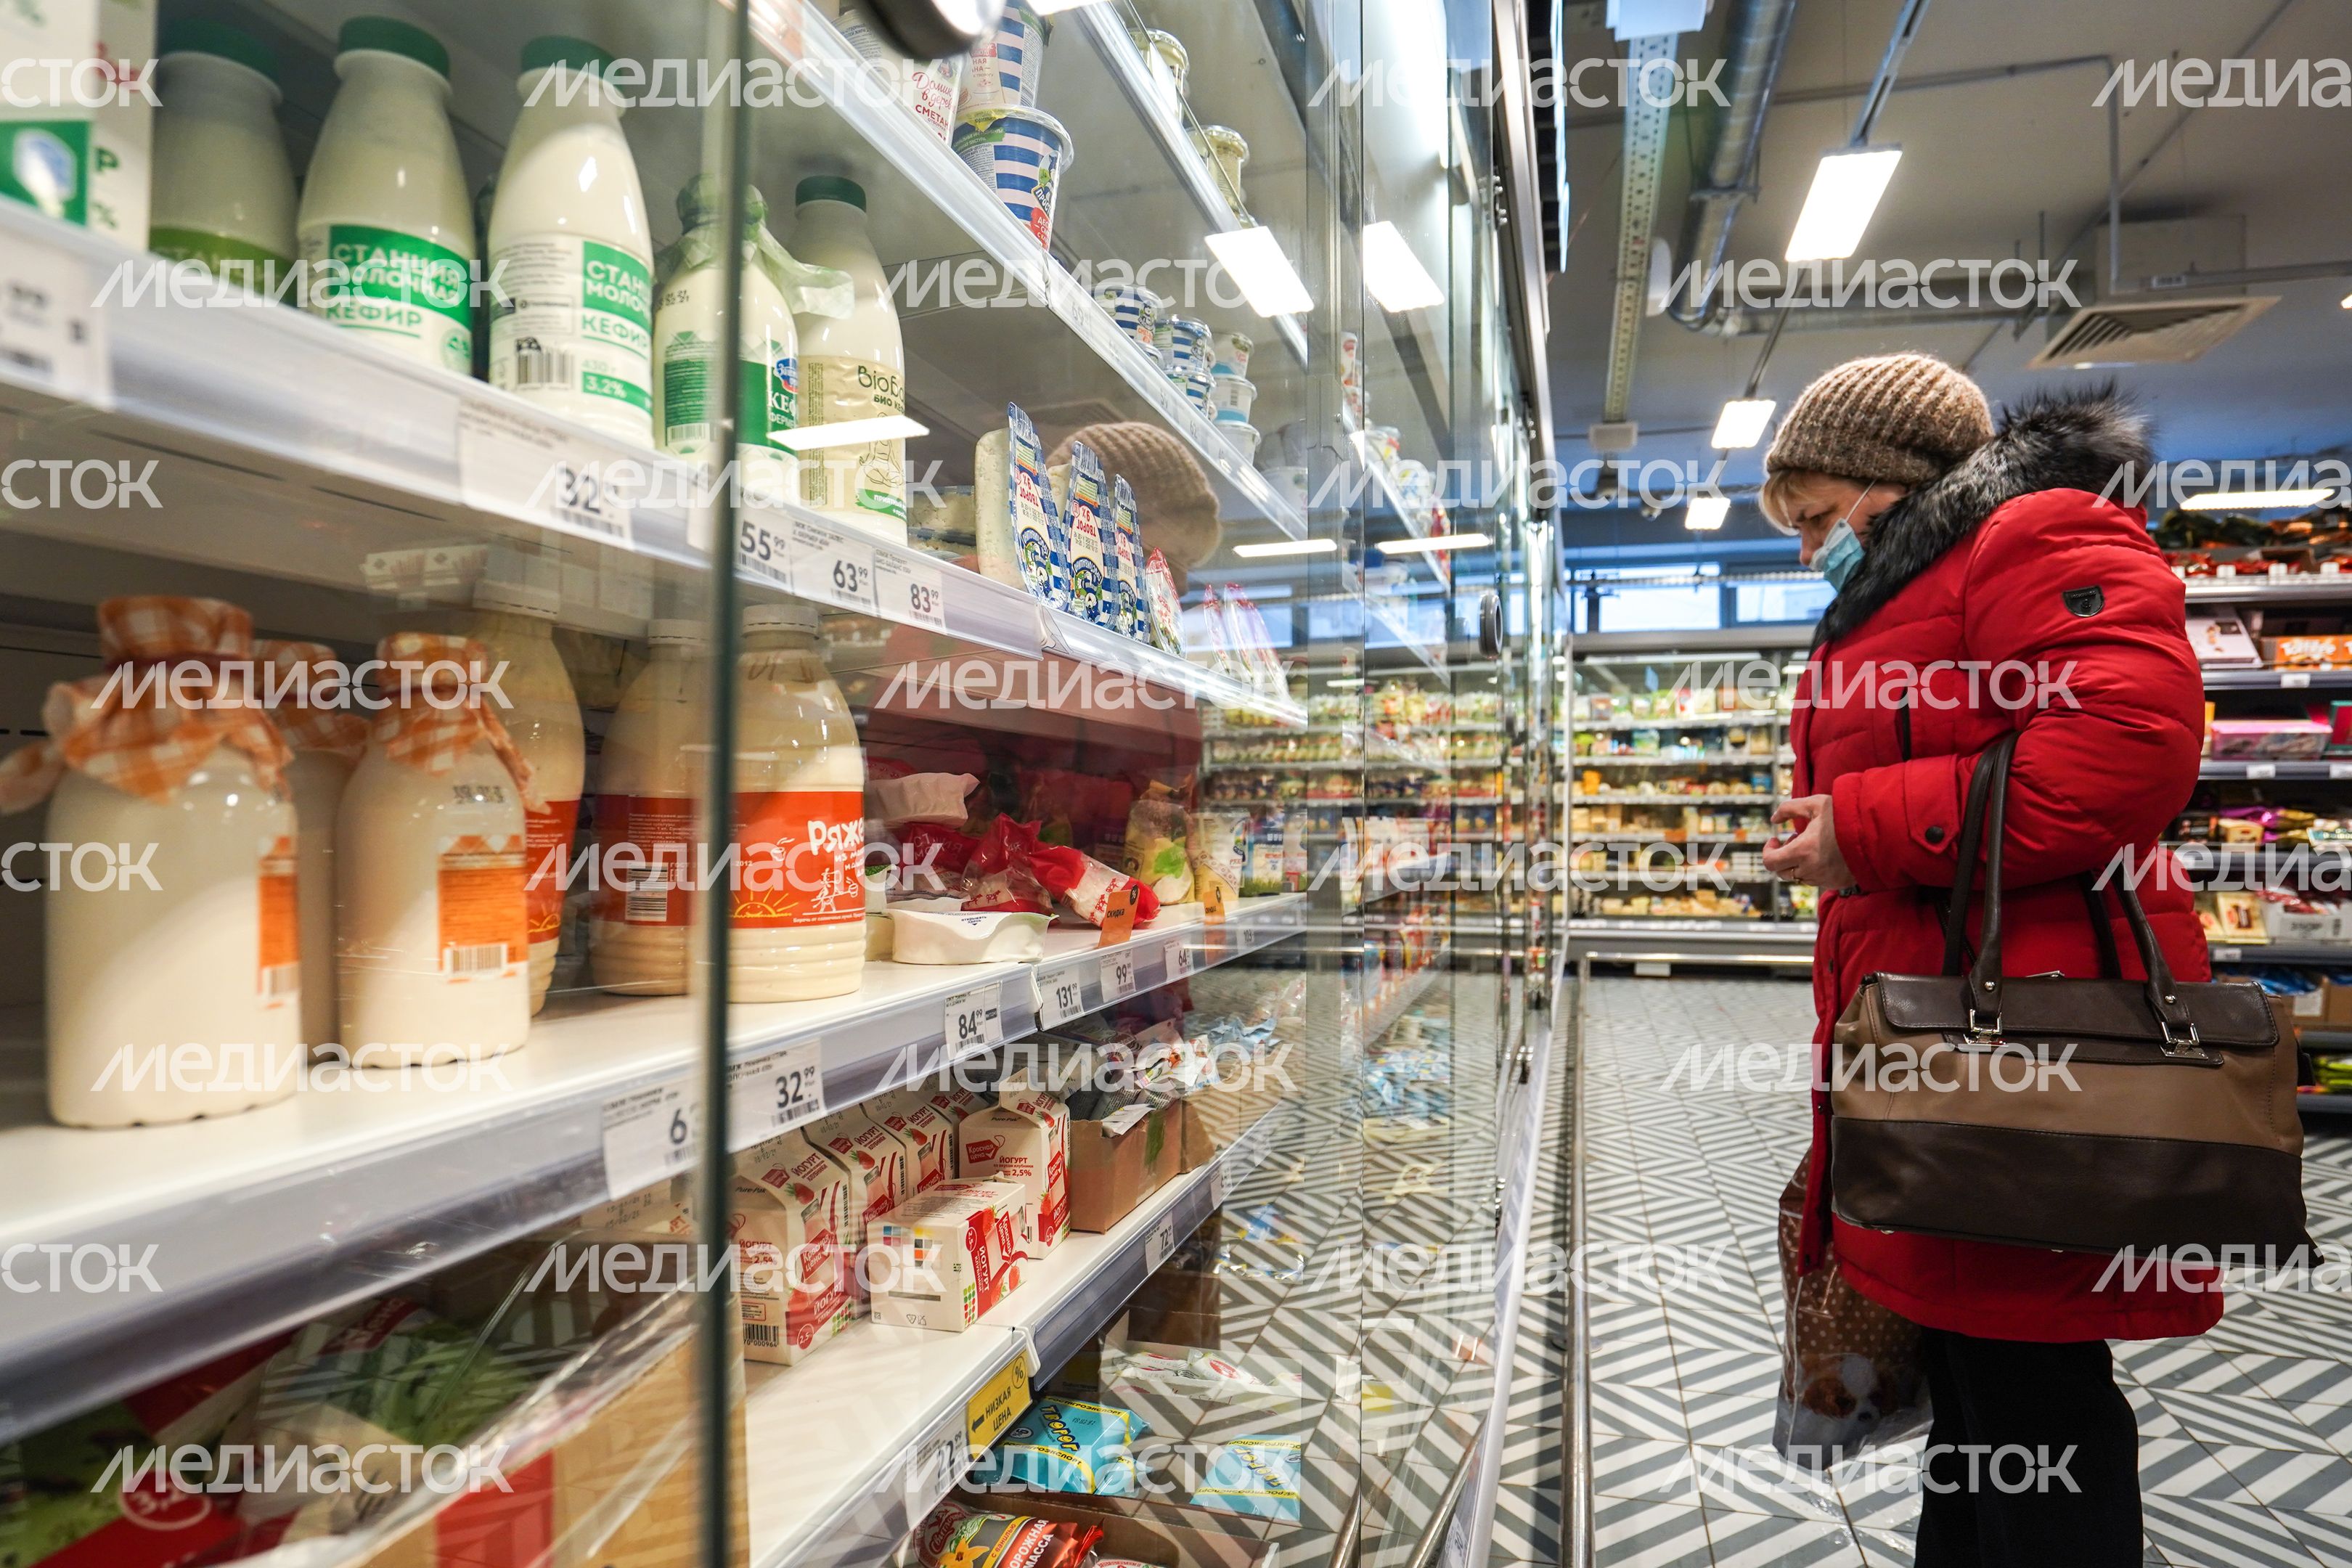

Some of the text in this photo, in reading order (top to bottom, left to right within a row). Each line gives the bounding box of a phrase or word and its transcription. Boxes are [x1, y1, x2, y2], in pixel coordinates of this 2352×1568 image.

[915, 104, 949, 127] СМЕТАН
[928, 91, 956, 115] дерев
[1035, 188, 1051, 213] ПРОСТ
[586, 259, 648, 296] СТАН
[327, 302, 422, 326] КЕФИР
[767, 391, 798, 415] КЕФ
[767, 412, 799, 428] ФЕРМЕ
[740, 520, 771, 561] 55
[1076, 518, 1096, 538] ТВОРОГ
[833, 559, 858, 592] 63
[910, 583, 931, 613] 83
[807, 816, 865, 856] Ряже
[1116, 964, 1127, 985] 99
[1055, 983, 1073, 1009] 131
[958, 1010, 977, 1040] 84
[775, 1071, 804, 1109] 32
[907, 1106, 932, 1124] ЙОГУРТ
[854, 1125, 881, 1146] ЙОГУРТ
[968, 1143, 995, 1156] Красная
[969, 1152, 986, 1161] цена
[999, 1155, 1029, 1164] ЙОГУРТ
[791, 1152, 822, 1177] ЙОГУРТ
[739, 1239, 773, 1250] ЙОГУРТ
[997, 1222, 1006, 1246] цена
[1002, 1215, 1012, 1254] Красная
[805, 1252, 822, 1272] цена
[979, 1246, 990, 1291] ЙОГУРТ
[813, 1279, 844, 1315] ЙОГУРТ
[984, 1385, 1012, 1420] НИЗКАЯ
[992, 1406, 1013, 1432] ЦЕНА
[995, 1523, 1017, 1553] ванилью
[1009, 1519, 1050, 1568] ОРОЖНАЯ
